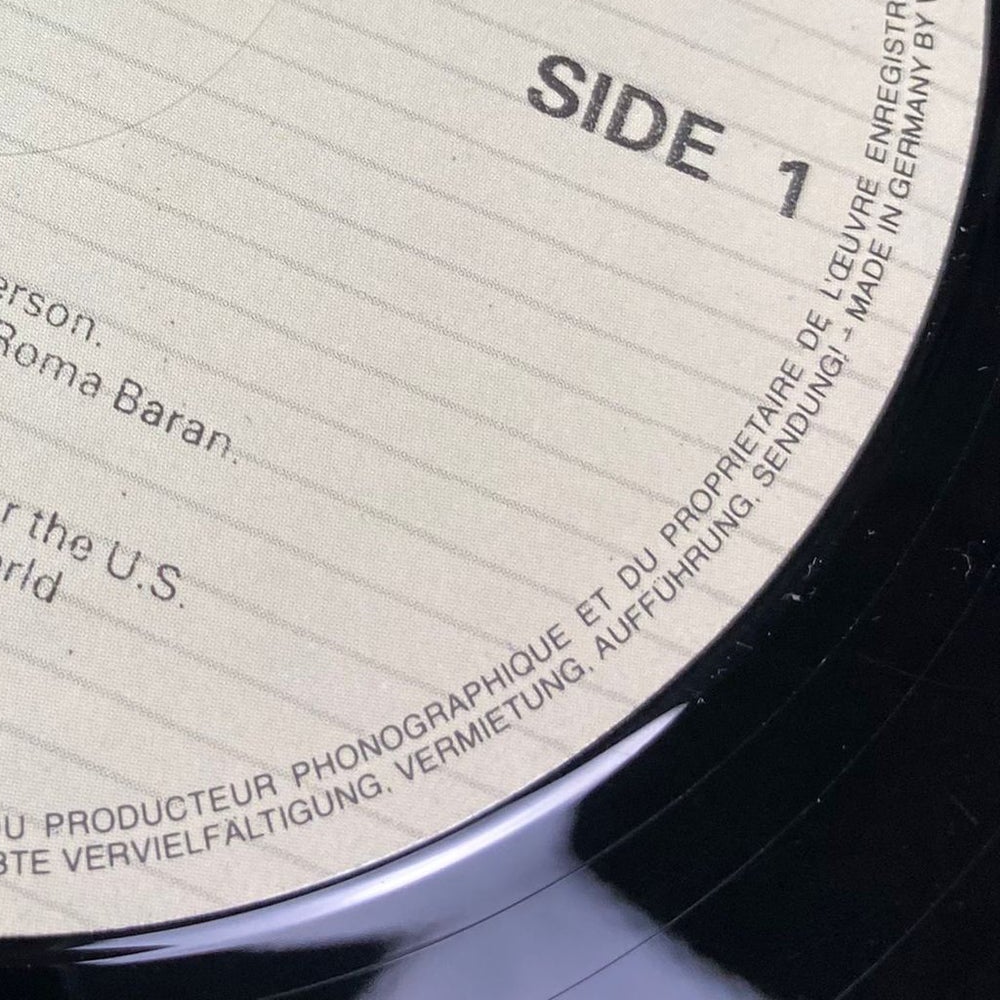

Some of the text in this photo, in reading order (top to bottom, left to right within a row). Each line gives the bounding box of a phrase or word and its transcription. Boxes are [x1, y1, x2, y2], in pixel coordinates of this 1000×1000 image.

[912, 11, 936, 51] BY
[526, 54, 811, 220] SIDE 1
[887, 55, 932, 200] GERMANY
[876, 203, 904, 235] IN
[844, 237, 893, 323] MADE
[112, 376, 237, 465] Baran.
[751, 344, 848, 488] SENDUNG!
[42, 772, 278, 839] PRODUCTEUR
[290, 622, 572, 789] PHONOGRAPHIQUE
[574, 586, 612, 628] ET
[615, 546, 658, 591] DU
[658, 357, 805, 548] PROPRIETAIRE
[795, 308, 834, 352] DE
[818, 174, 881, 301] L'ŒUVRE
[27, 508, 94, 563] the
[105, 539, 185, 609] U.S.
